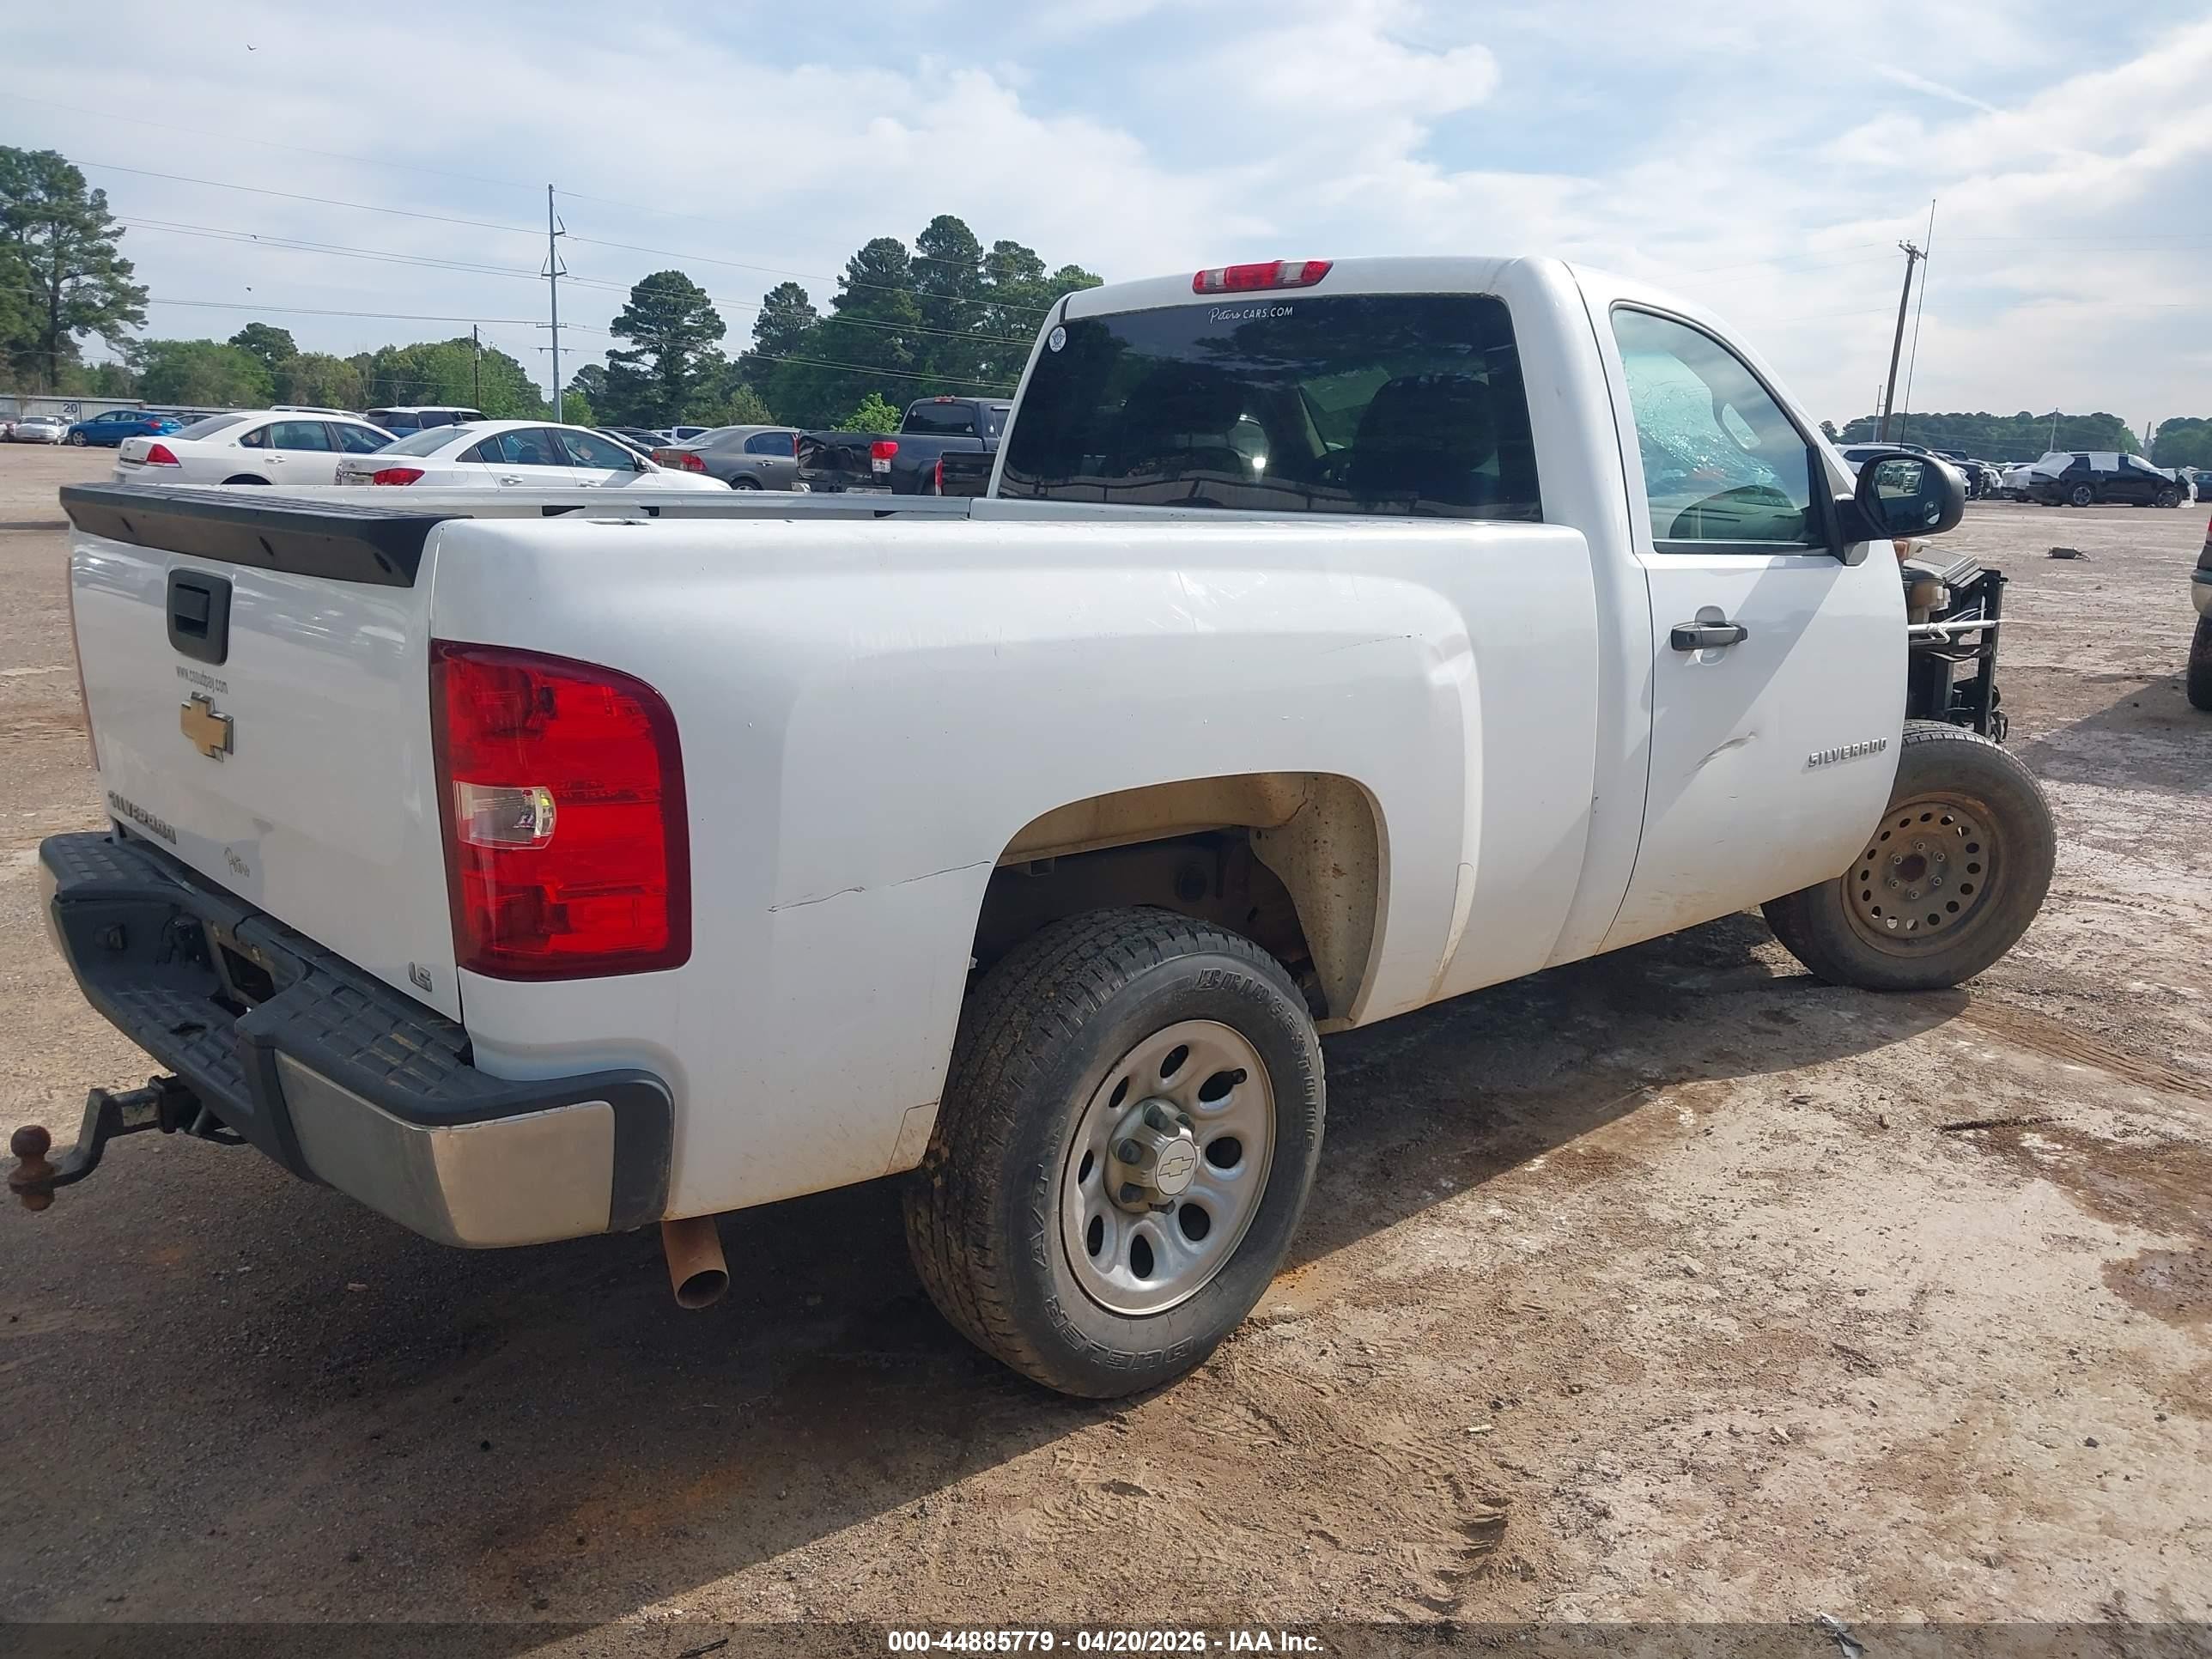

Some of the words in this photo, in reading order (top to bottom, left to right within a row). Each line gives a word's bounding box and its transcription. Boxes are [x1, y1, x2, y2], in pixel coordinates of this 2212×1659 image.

[1243, 306, 1293, 319] CARS.COM
[63, 403, 78, 413] 20
[1808, 737, 1887, 768] SILVERADO
[408, 961, 433, 993] LS
